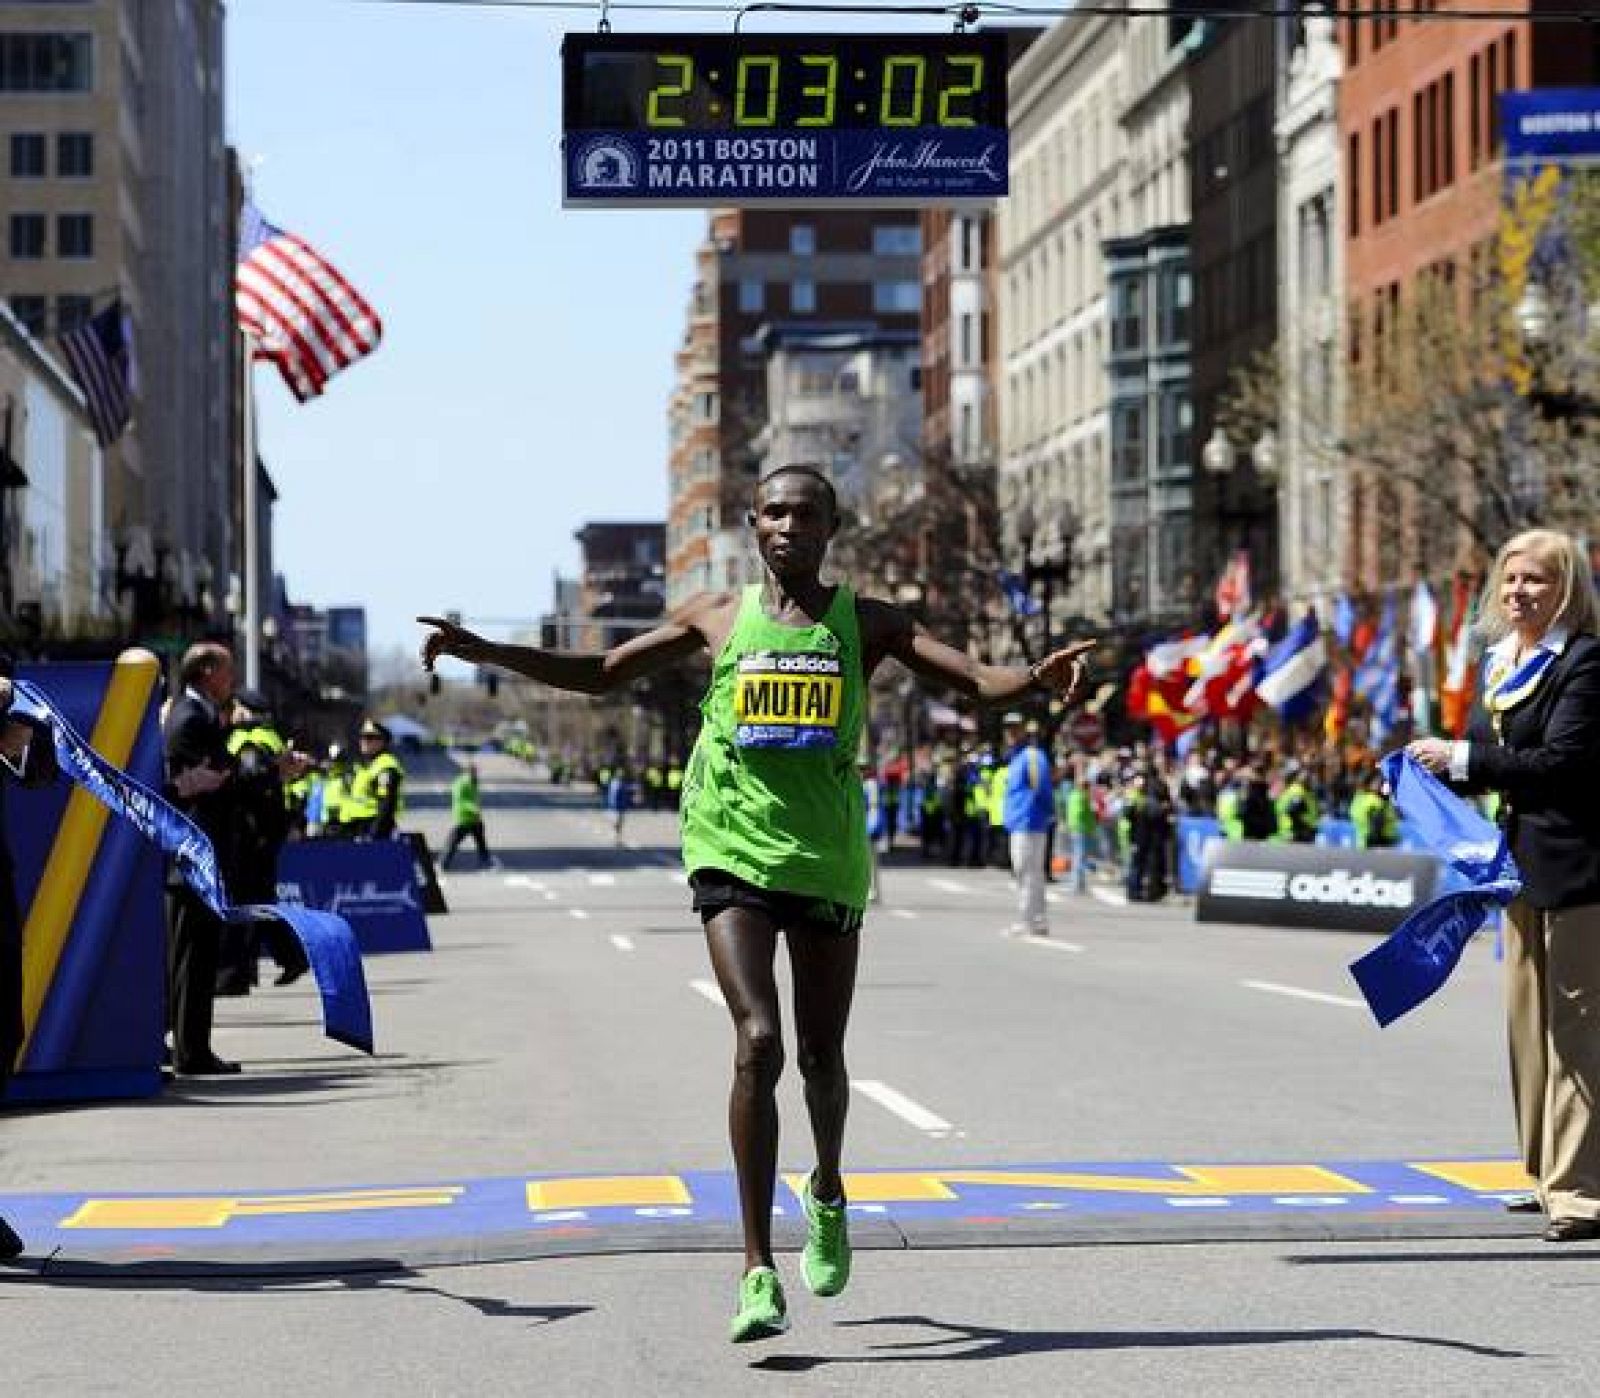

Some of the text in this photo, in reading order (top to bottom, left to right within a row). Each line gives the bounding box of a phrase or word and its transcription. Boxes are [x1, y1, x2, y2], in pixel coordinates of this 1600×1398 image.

[646, 55, 984, 127] 2:03:02
[648, 139, 817, 160] 2011 BOSTON
[847, 139, 1001, 191] John Hancock
[648, 164, 817, 187] MARATHON
[744, 680, 833, 718] MUTAI
[1289, 869, 1415, 908] adidas
